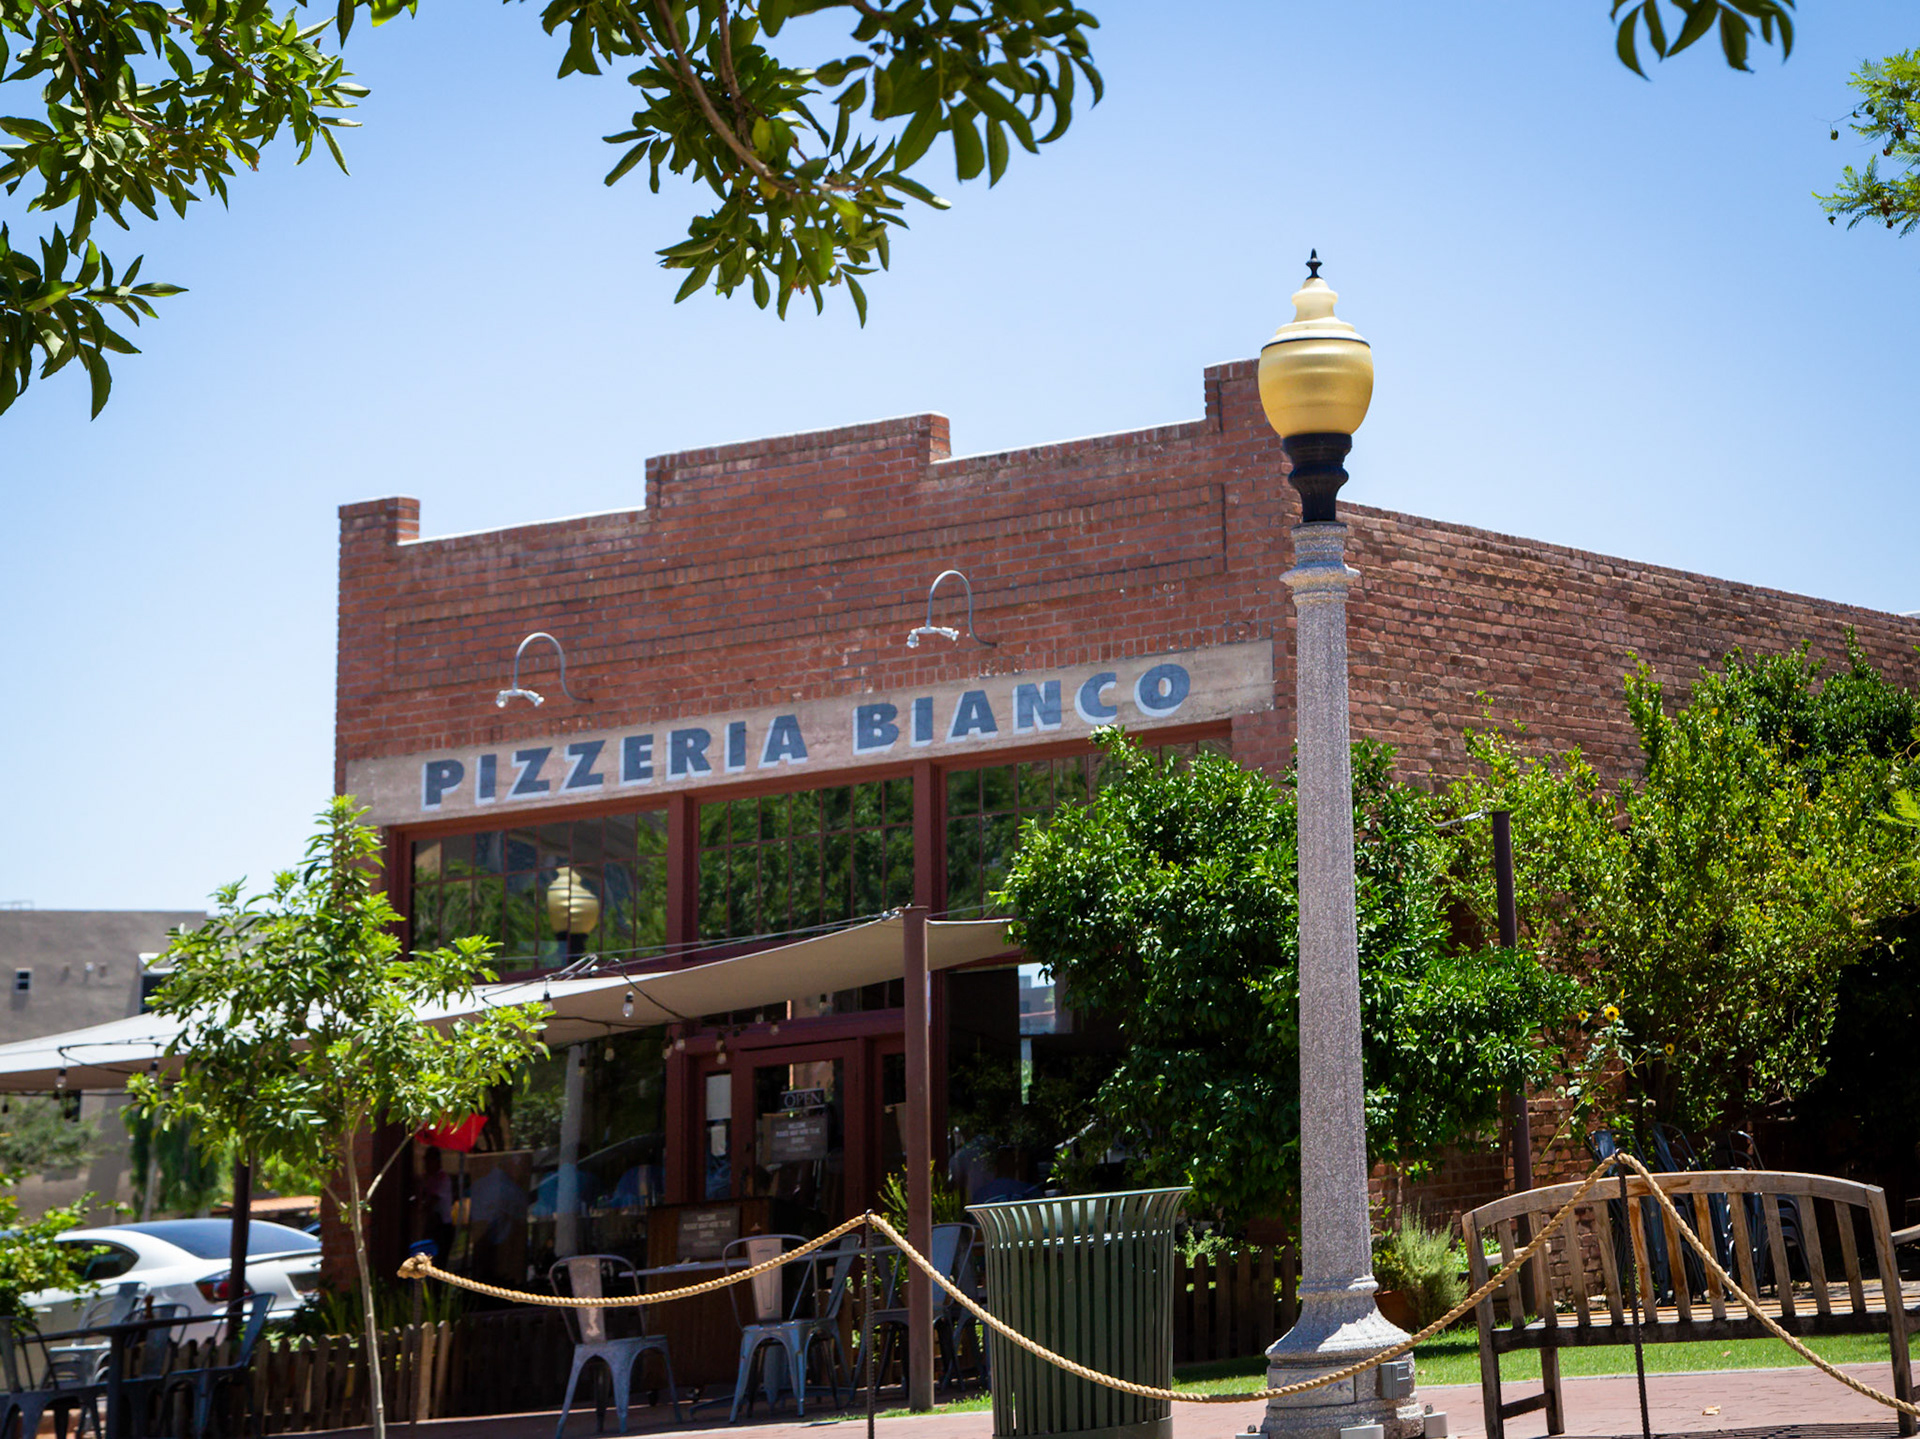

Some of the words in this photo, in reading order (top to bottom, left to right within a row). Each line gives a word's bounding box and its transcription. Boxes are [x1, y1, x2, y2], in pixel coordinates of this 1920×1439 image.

[421, 714, 808, 811] PIZZERIA
[853, 663, 1191, 755] BIANCO
[784, 1091, 822, 1108] OPEN
